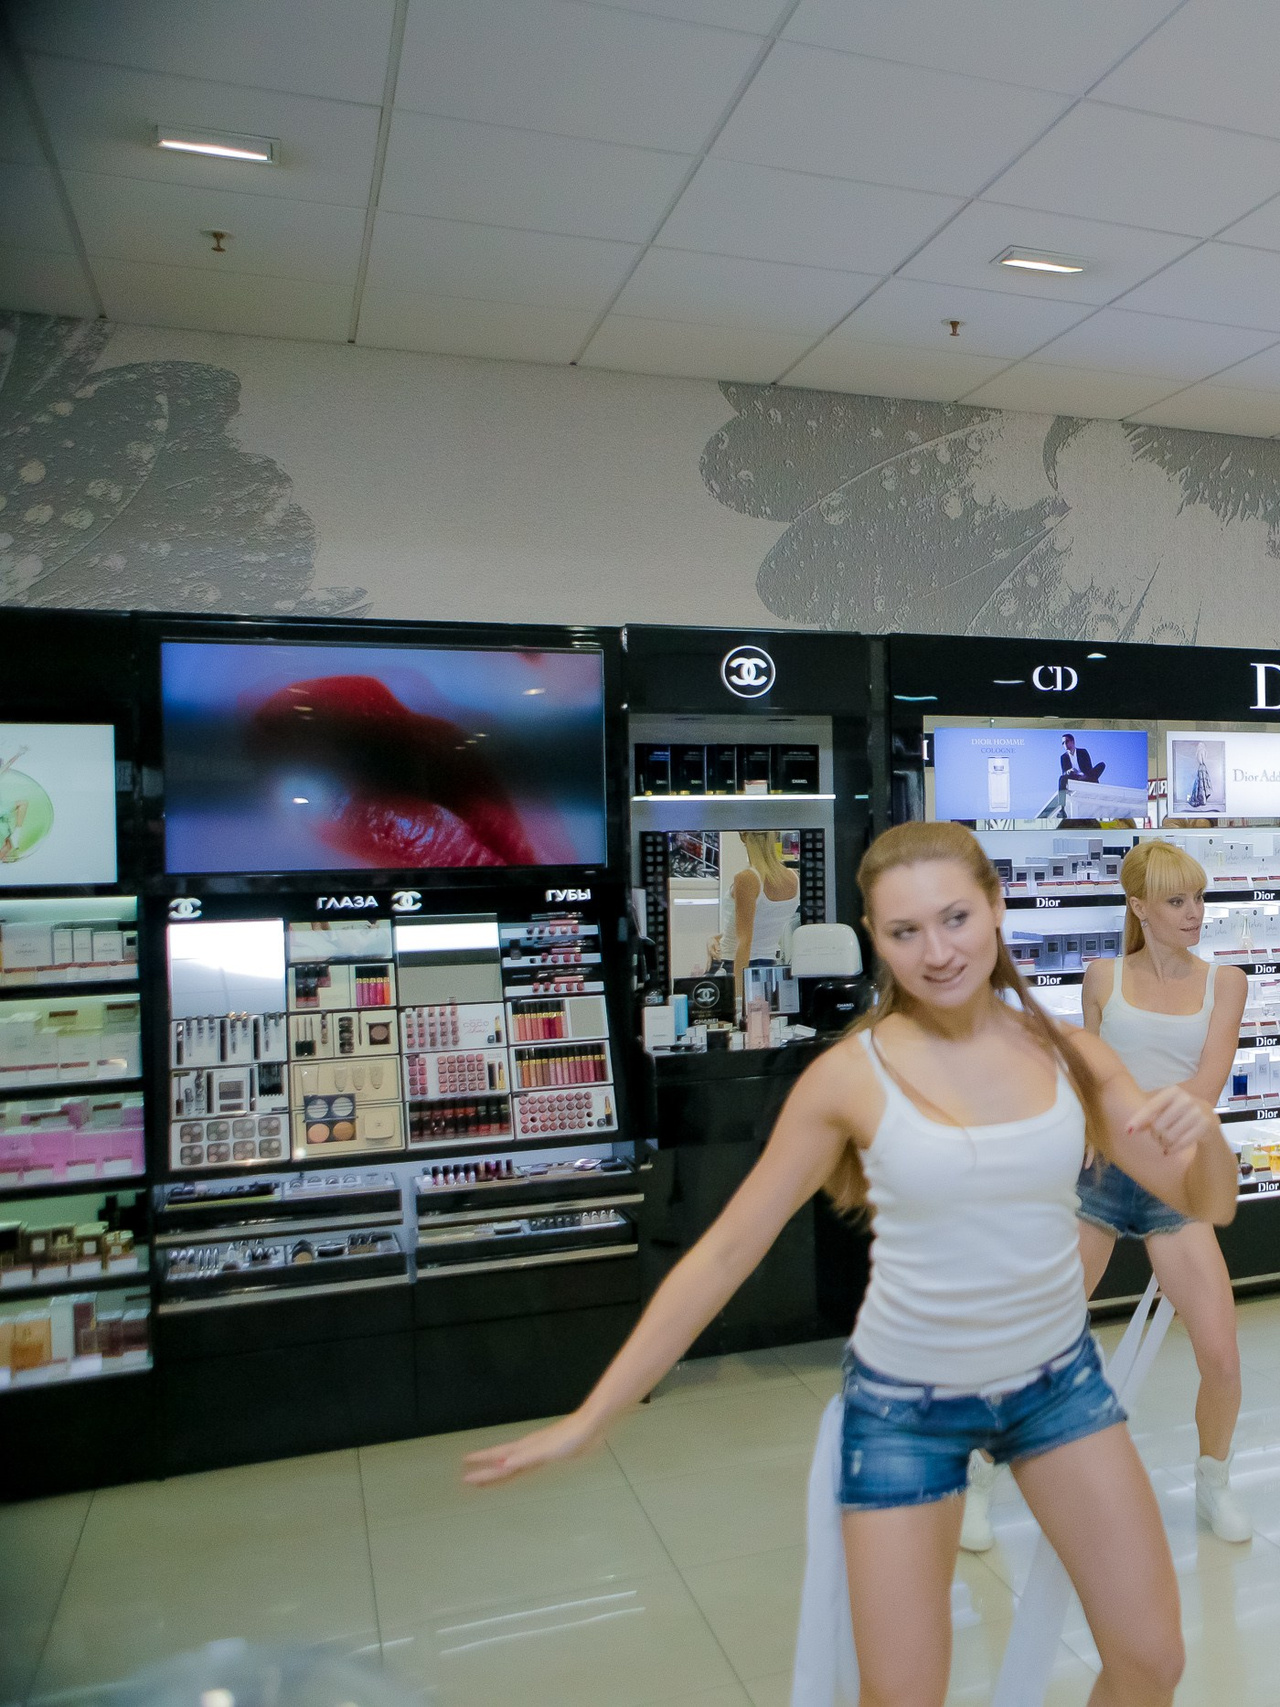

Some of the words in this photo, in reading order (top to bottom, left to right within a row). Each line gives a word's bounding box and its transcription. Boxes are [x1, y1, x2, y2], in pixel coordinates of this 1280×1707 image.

[971, 738, 992, 746] DIOR
[994, 738, 1025, 746] HOMME
[1233, 768, 1259, 783] Dior
[545, 888, 592, 902] ГУБЫ
[1253, 890, 1276, 900] Dior
[317, 895, 379, 910] ГЛАЗА
[1036, 897, 1060, 907] Dior
[1255, 964, 1277, 974] Dior
[1037, 975, 1062, 985] Dior
[1255, 1037, 1277, 1047] Dior
[1256, 1109, 1278, 1120] Dior
[1258, 1182, 1280, 1192] Dior
